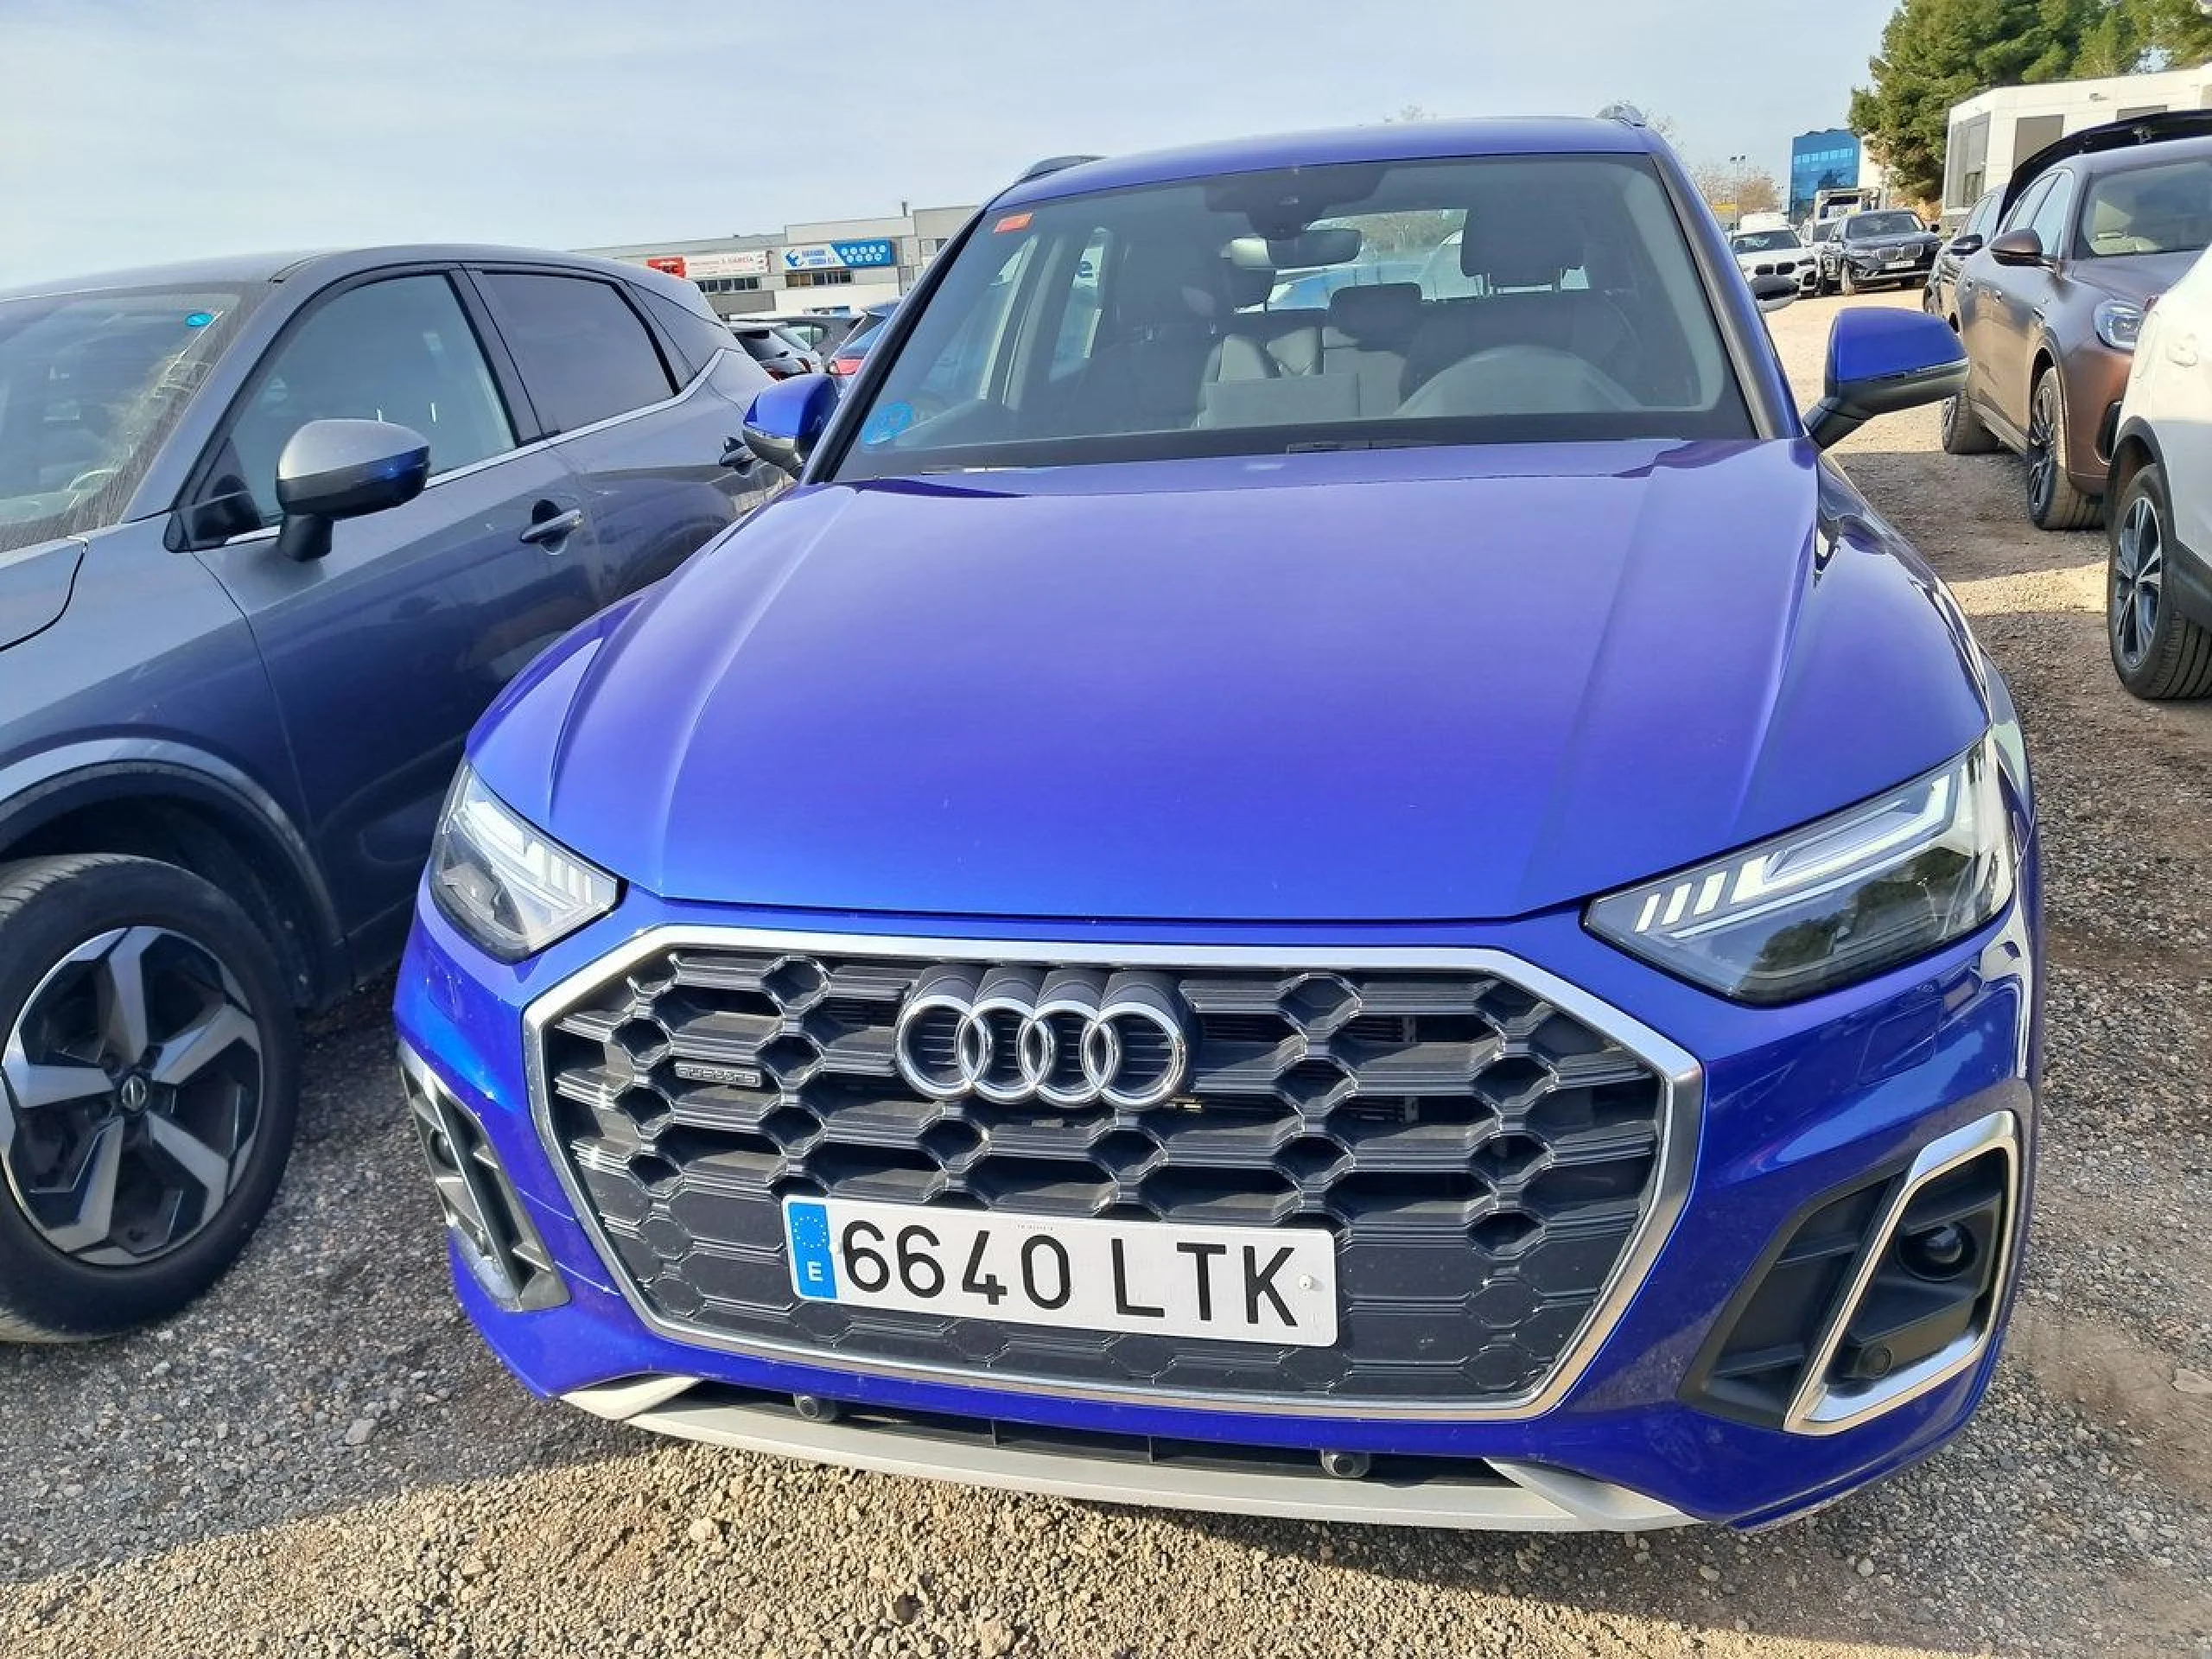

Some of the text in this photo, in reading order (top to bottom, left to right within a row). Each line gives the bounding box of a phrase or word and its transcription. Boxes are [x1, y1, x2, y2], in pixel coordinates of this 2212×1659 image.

[807, 1261, 823, 1282] E
[842, 1219, 1300, 1328] 6640 LTK
